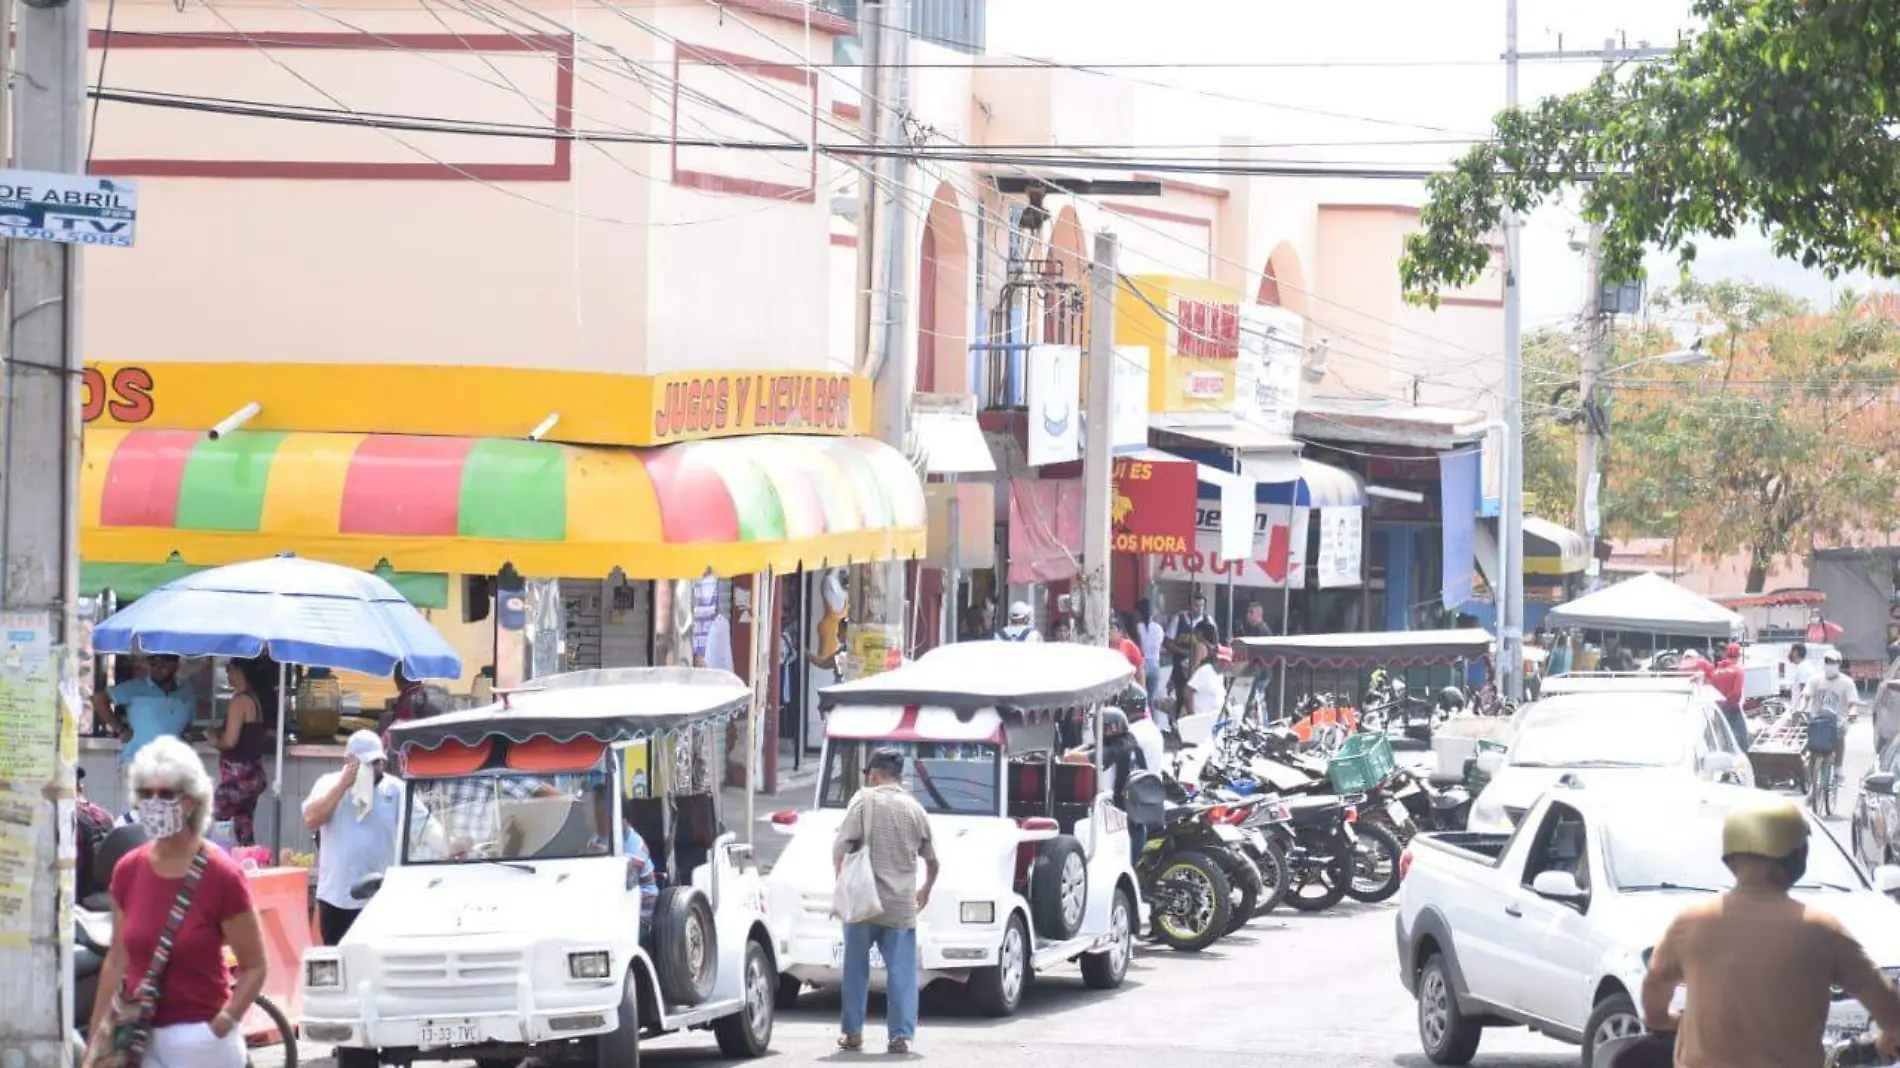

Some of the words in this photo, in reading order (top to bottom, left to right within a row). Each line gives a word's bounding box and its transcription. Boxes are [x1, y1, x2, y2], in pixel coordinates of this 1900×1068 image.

[0, 185, 33, 201] DE
[43, 190, 129, 210] ABRIL
[655, 376, 729, 436] JUGOS
[736, 376, 751, 427] Y
[1129, 463, 1152, 480] ES
[1141, 535, 1187, 553] MORA
